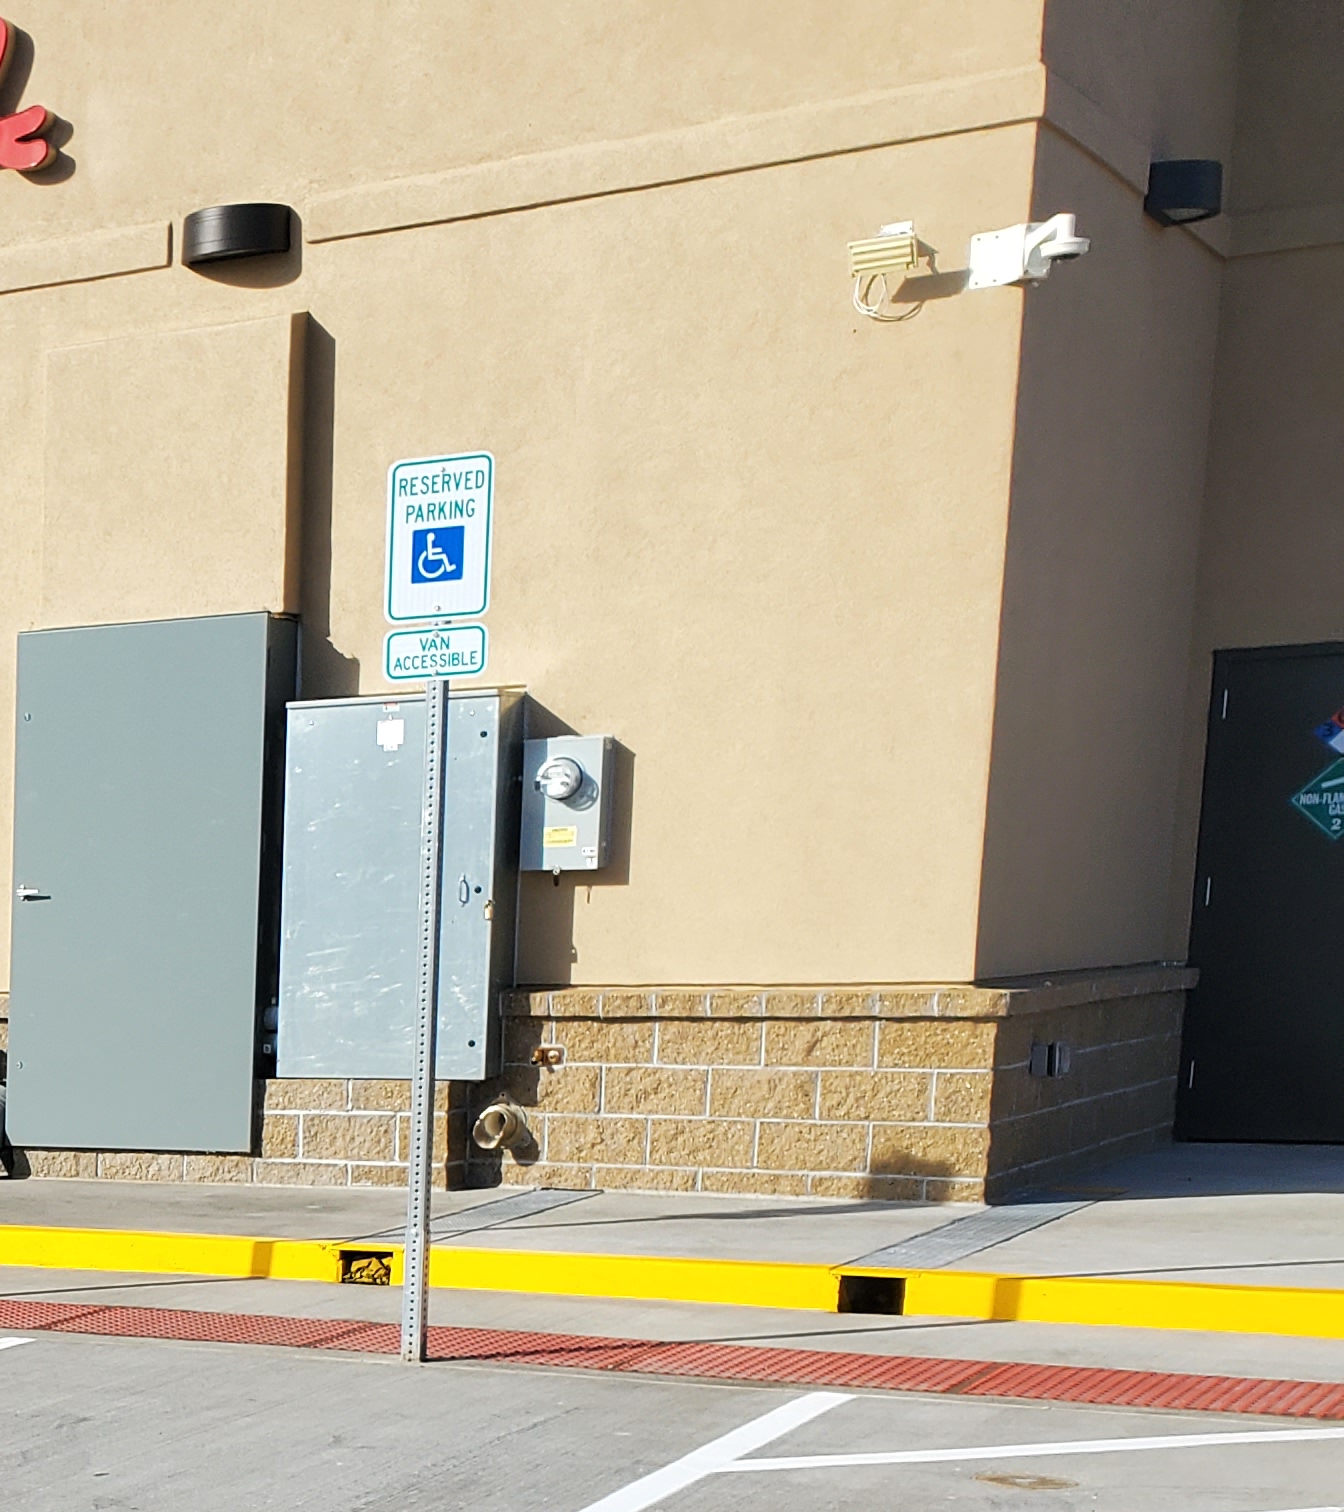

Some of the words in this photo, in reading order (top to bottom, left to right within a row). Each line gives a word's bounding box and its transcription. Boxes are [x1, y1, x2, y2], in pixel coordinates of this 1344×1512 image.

[398, 469, 485, 497] RESERVED
[405, 498, 475, 524] PARKING
[419, 636, 450, 651] VAN
[393, 650, 478, 671] ACCESSIBLE
[1330, 818, 1342, 830] 2
